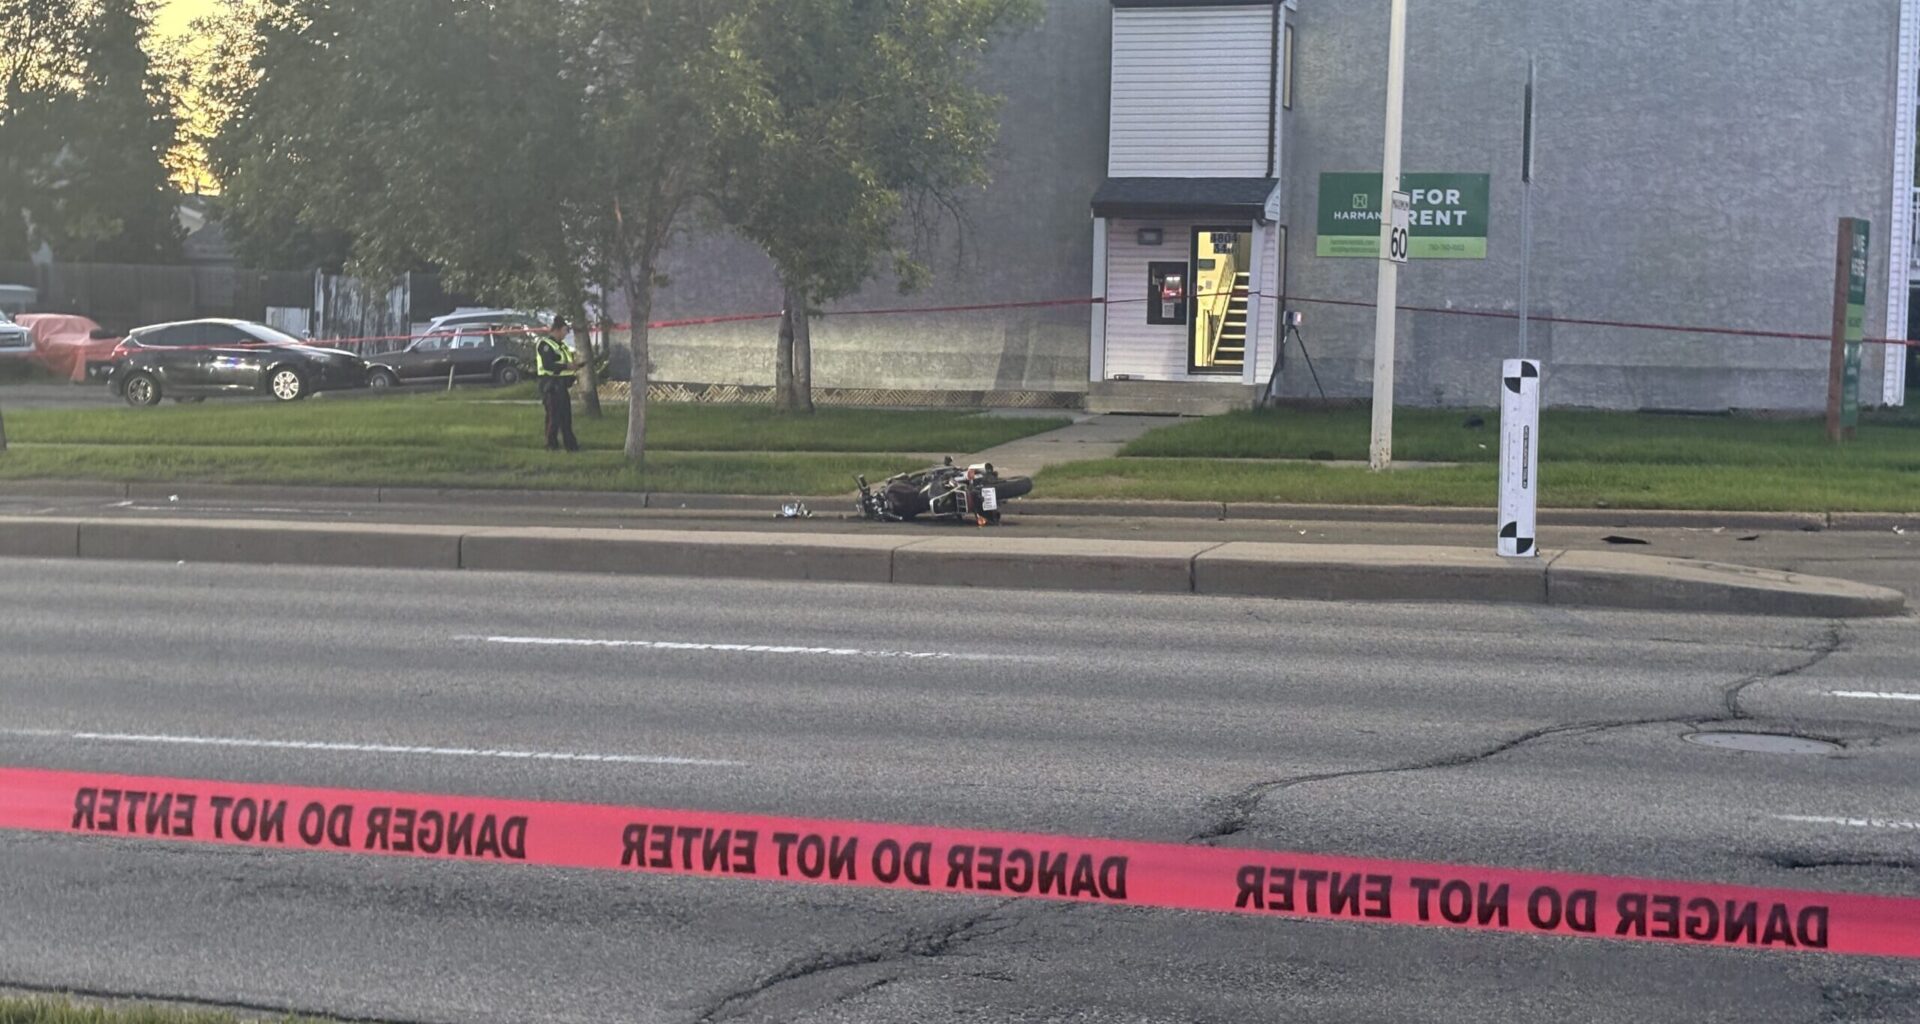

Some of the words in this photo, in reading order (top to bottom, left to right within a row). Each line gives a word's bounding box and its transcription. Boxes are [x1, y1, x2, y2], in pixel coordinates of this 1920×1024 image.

[1411, 188, 1461, 205] FOR
[1333, 211, 1382, 220] HARMAN
[1408, 210, 1467, 226] RENT
[1391, 227, 1408, 259] 60
